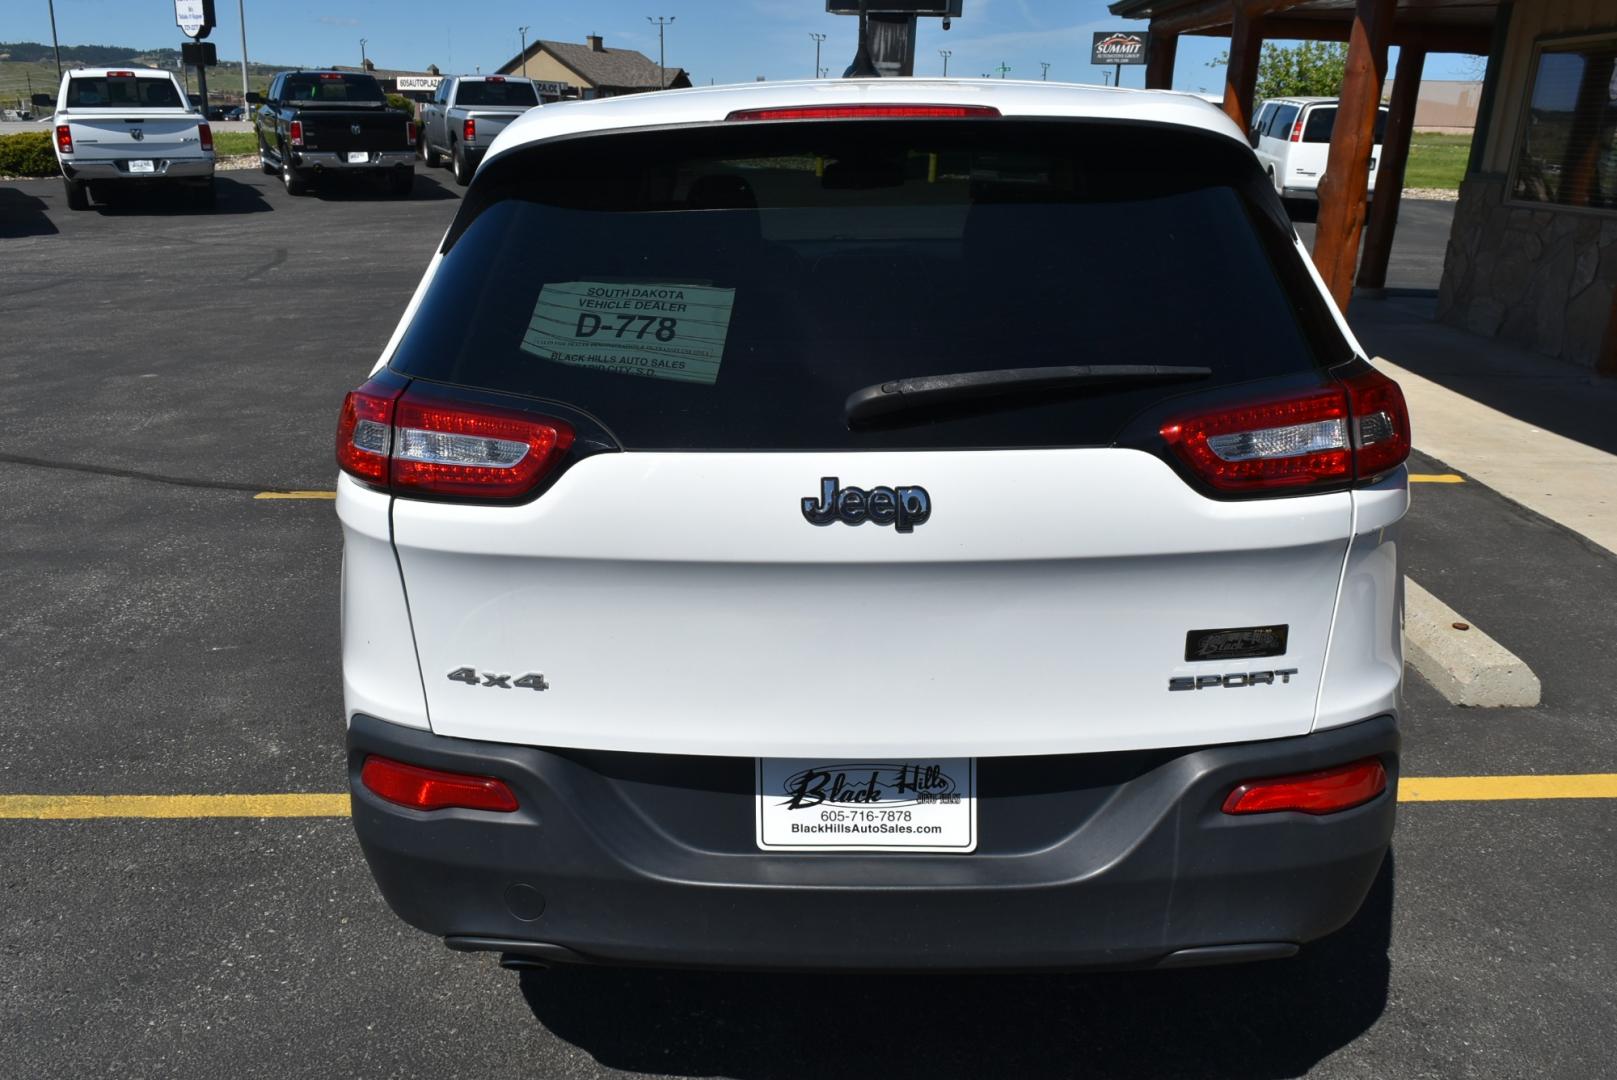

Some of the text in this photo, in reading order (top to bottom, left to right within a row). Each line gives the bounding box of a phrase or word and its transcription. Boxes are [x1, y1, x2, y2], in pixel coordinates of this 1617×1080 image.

[1096, 44, 1142, 54] SUMMIT
[586, 288, 684, 300] SOUTH DAKOTA
[578, 298, 687, 313] VEHICLE DEALER
[575, 313, 677, 342] D-778
[550, 351, 687, 369] BLACK HILLS AUTO SALES
[801, 476, 932, 534] Jeep
[1168, 668, 1298, 691] SPORT
[775, 763, 947, 811] Black Hills
[820, 810, 912, 822] 605-716-7878
[791, 823, 942, 834] BlackHillsAutoSales.com
